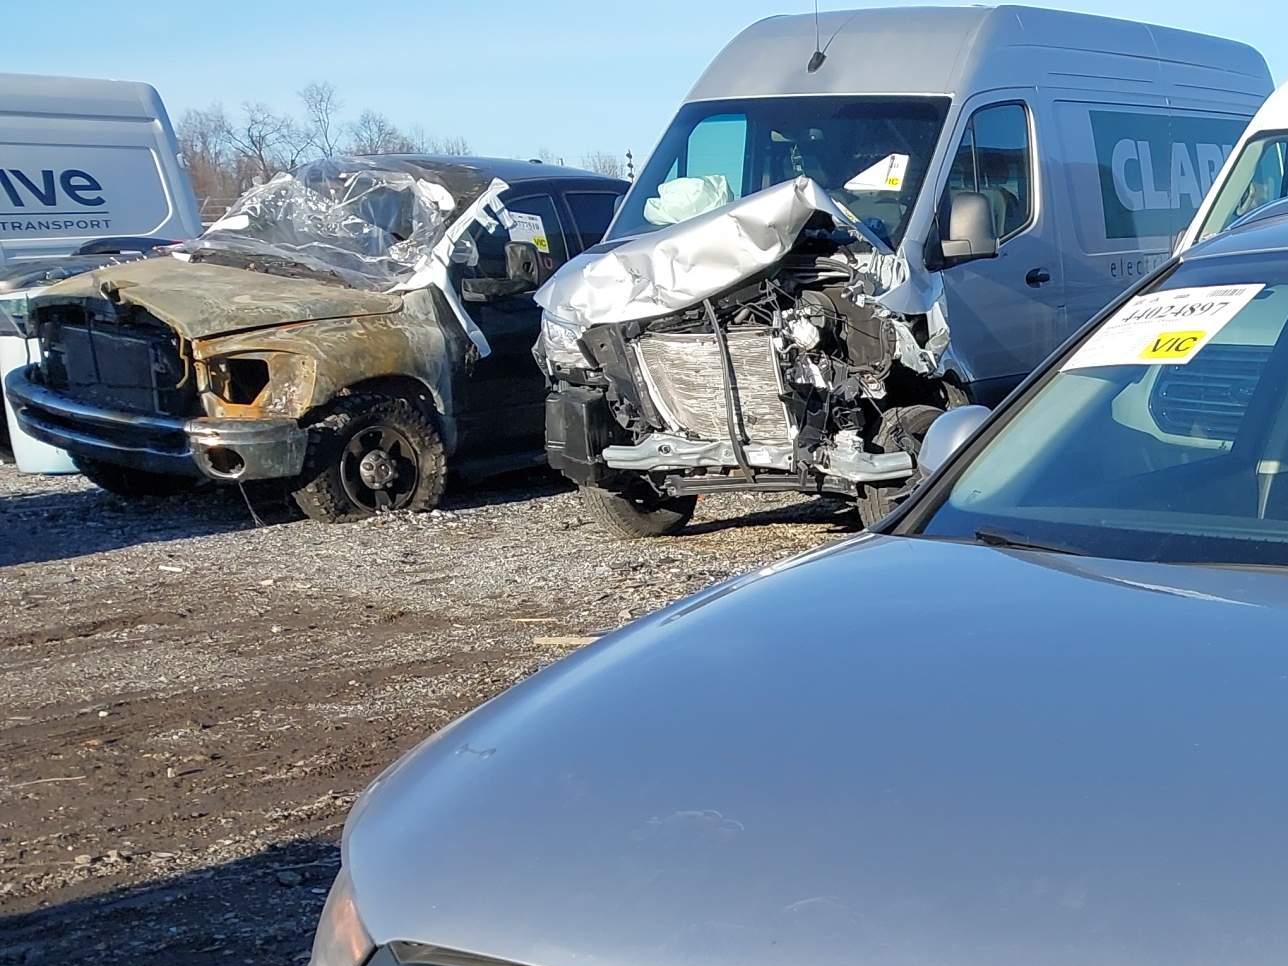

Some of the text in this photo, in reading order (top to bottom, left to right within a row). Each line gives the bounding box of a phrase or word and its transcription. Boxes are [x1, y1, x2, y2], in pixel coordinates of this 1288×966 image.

[0, 219, 112, 231] TRANSPORT
[1121, 301, 1232, 323] 44024897
[1151, 336, 1198, 353] VIC
